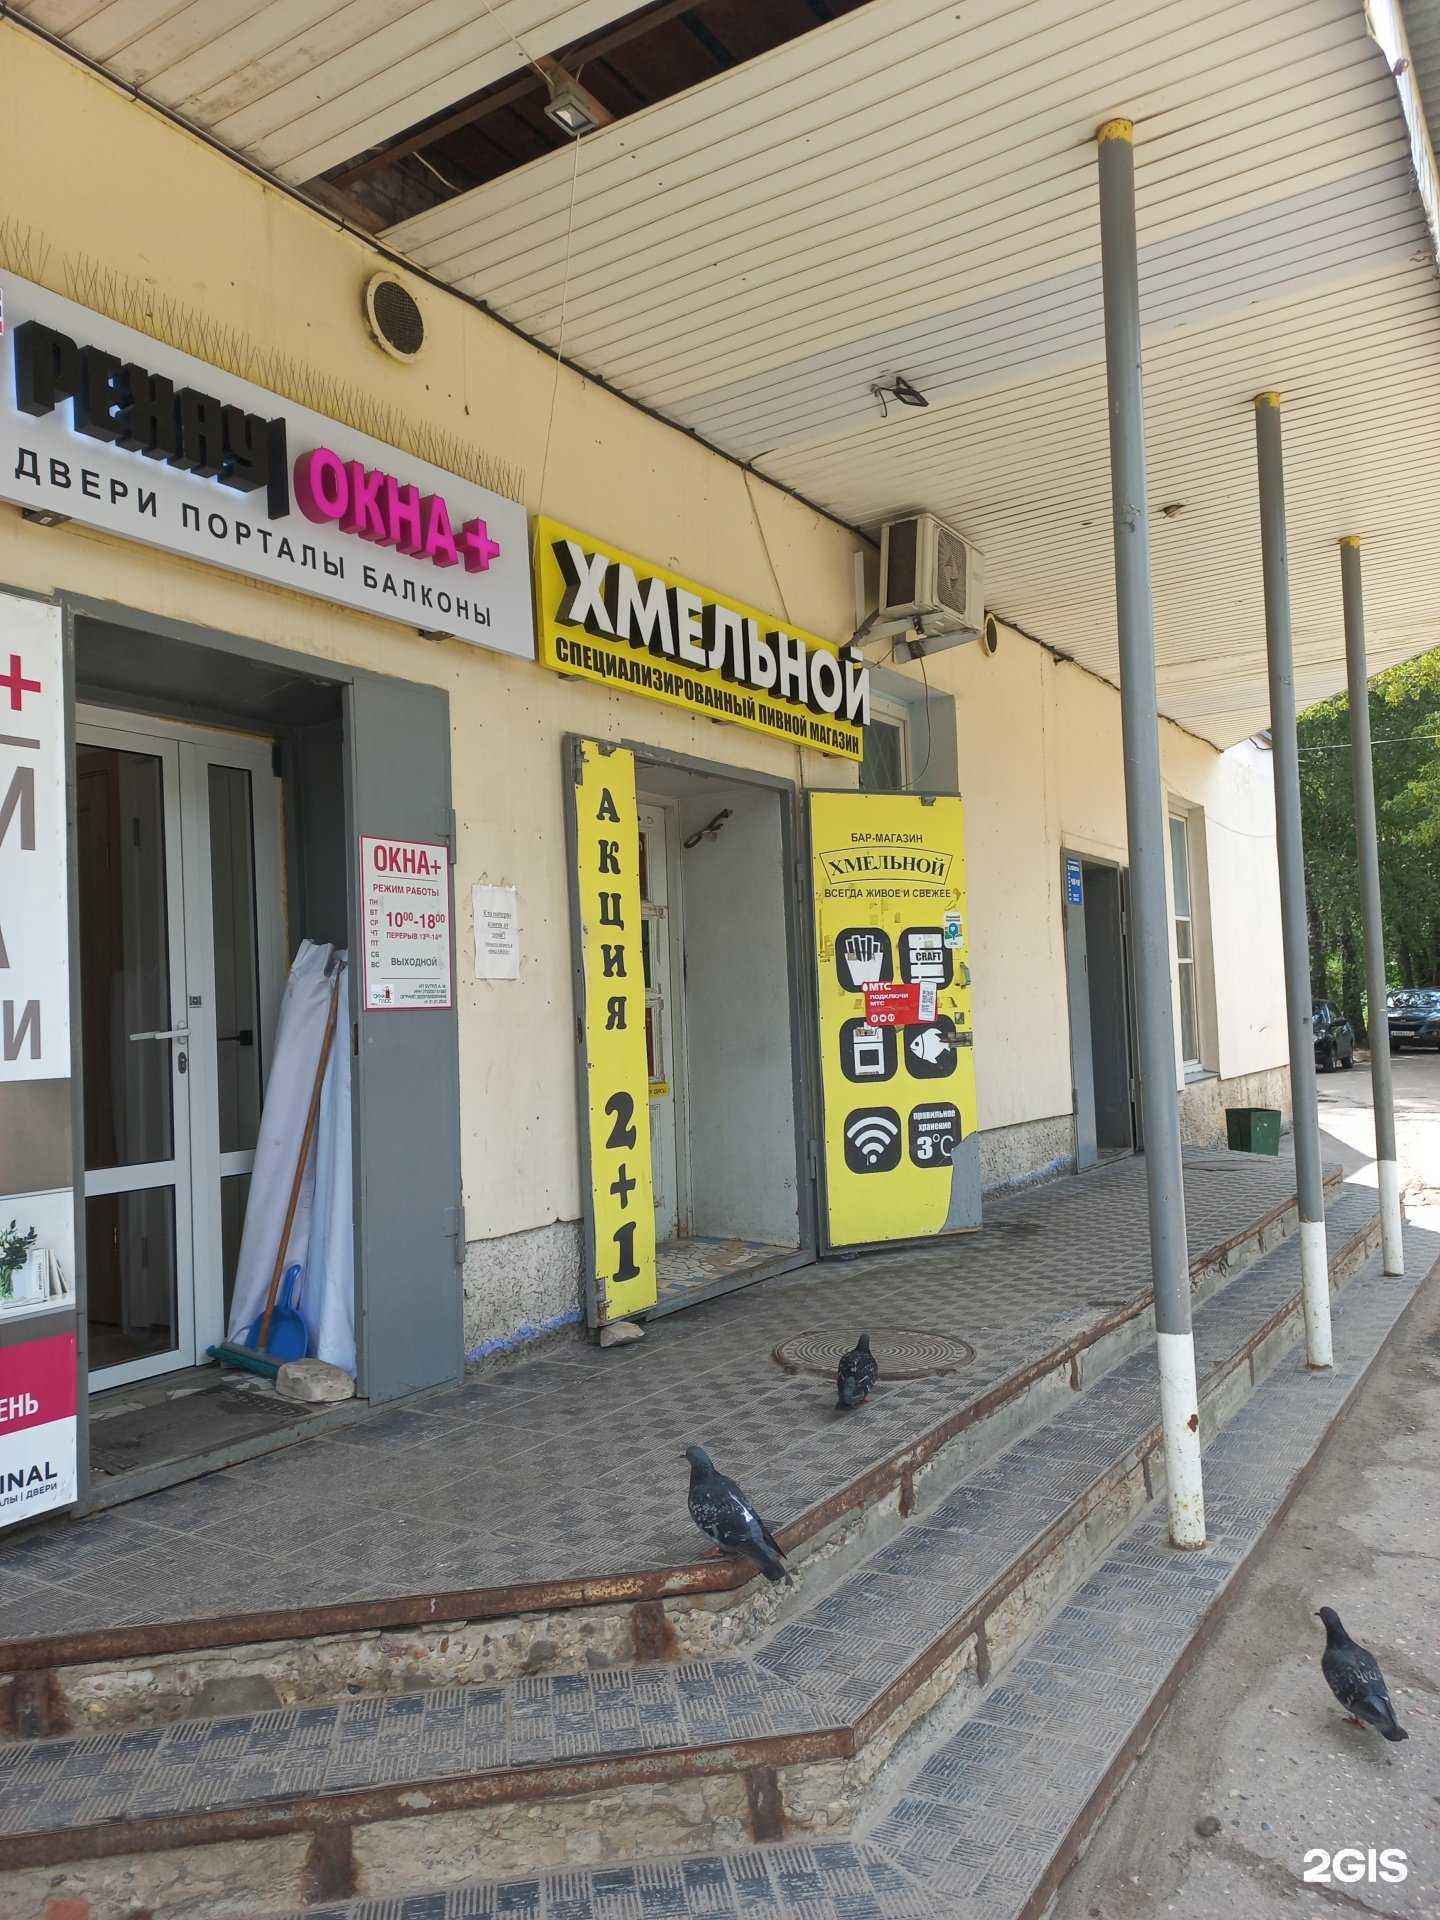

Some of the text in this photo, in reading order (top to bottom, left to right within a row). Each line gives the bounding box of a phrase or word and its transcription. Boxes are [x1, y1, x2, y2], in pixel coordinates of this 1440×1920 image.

[293, 447, 500, 574] ОКНА+
[15, 447, 491, 627] ДВЕРИ ПОРТАЛЫ БАЛКОНЫ
[552, 539, 871, 727] ХМЕЛЬНОЙ
[555, 636, 859, 754] СПЕЦИАЛИЗИРОВАННЫЙ ПИВНОЙ МАГАЗИН
[851, 832, 923, 843] БАР-МАГАЗИН
[373, 845, 442, 876] ОКНА+
[828, 855, 946, 877] ХМЕЛЬНОЙ
[373, 884, 440, 897] РЕЖИМ РАБОТЫ
[824, 888, 951, 899] ВСЕГДА ЖИВОЕ И СВЕЖЕЕ
[370, 929, 379, 937] ЧТ
[386, 931, 418, 940] ПЕРЕРЫВ
[391, 956, 438, 967] ВЫХОДНОЙ
[915, 951, 942, 962] CRAFT
[870, 983, 892, 991] МТС
[596, 787, 641, 1283] АКЦИЯ 2+1
[26, 1482, 57, 1499] ДВЕРИ
